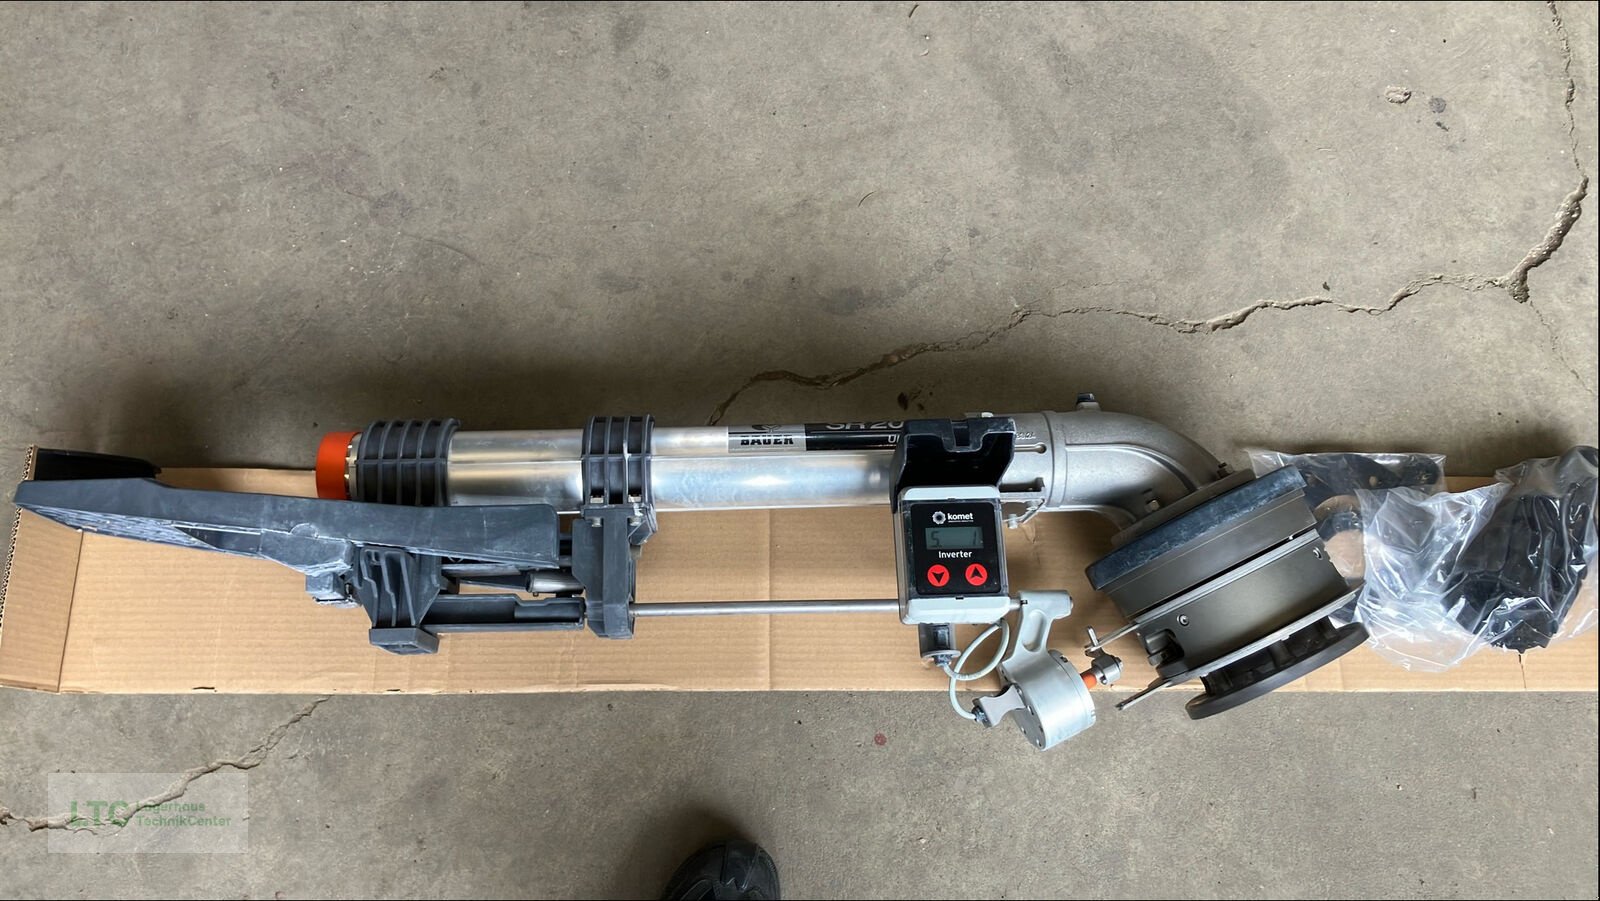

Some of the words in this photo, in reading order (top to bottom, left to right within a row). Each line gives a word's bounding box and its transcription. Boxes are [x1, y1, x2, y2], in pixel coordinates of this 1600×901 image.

[740, 434, 794, 446] BAUER
[888, 434, 899, 443] U
[947, 512, 974, 520] komet
